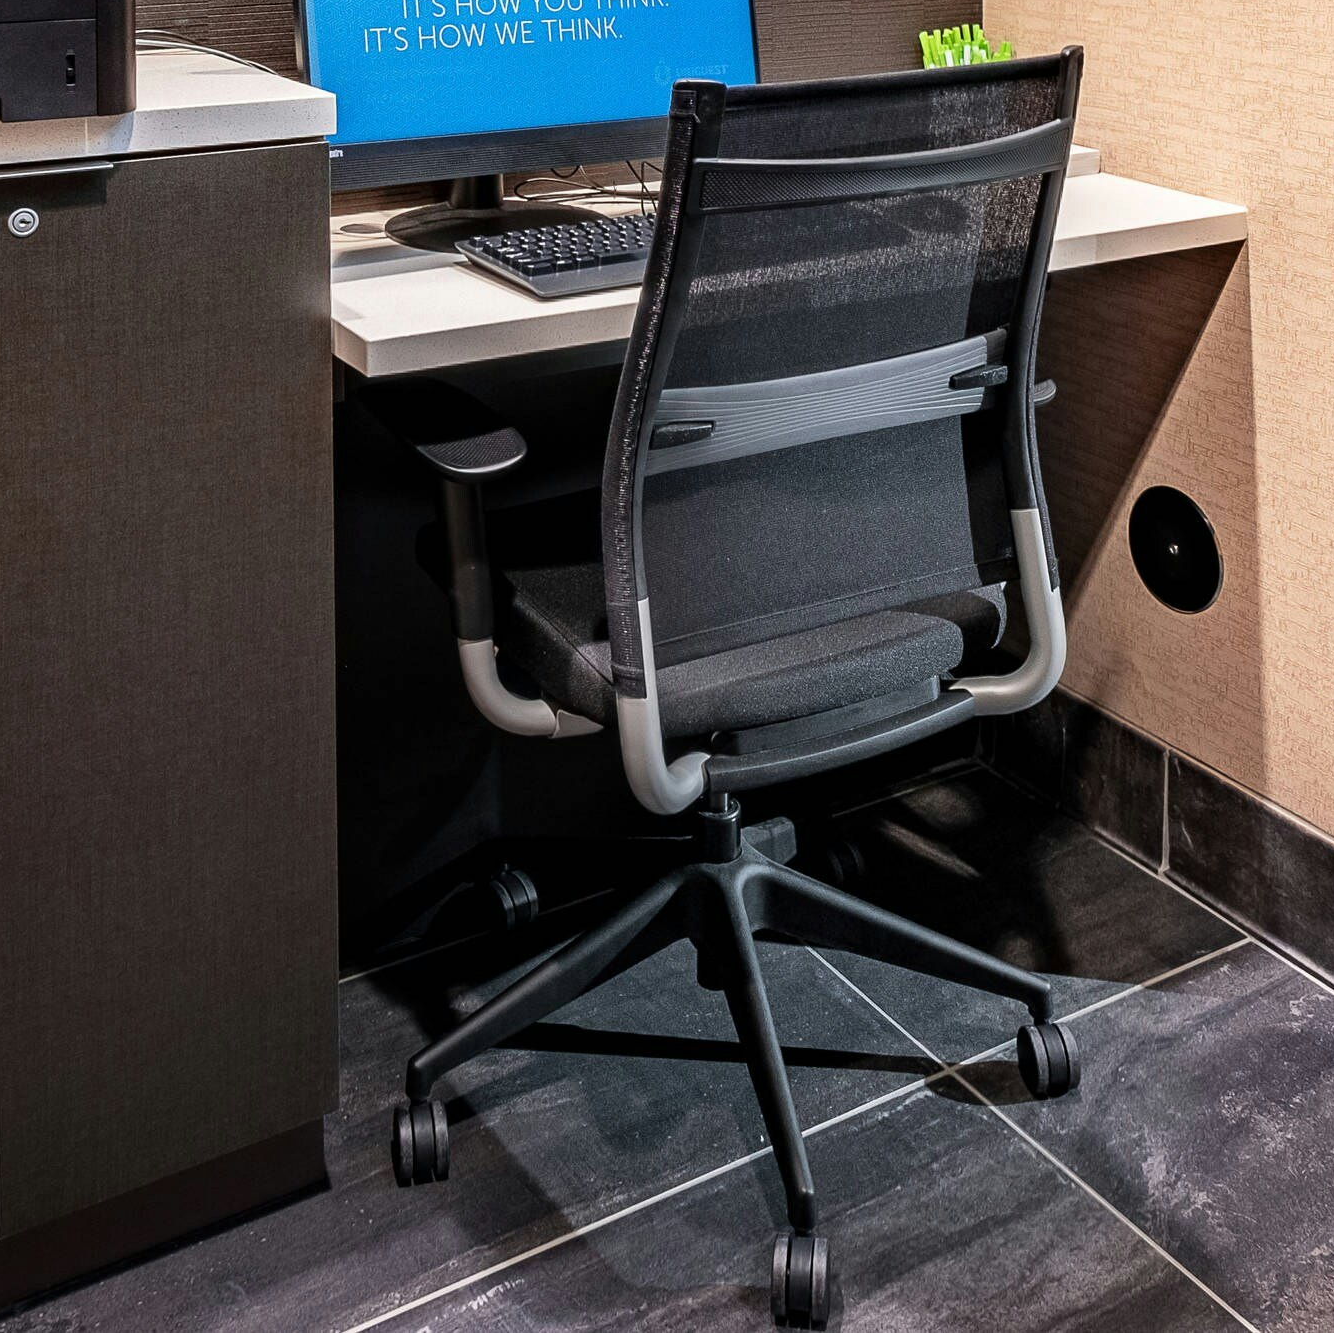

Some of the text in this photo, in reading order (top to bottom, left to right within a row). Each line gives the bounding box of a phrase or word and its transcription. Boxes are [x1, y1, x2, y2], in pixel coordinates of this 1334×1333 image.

[363, 16, 624, 53] IT'S HOW WE THINK.
